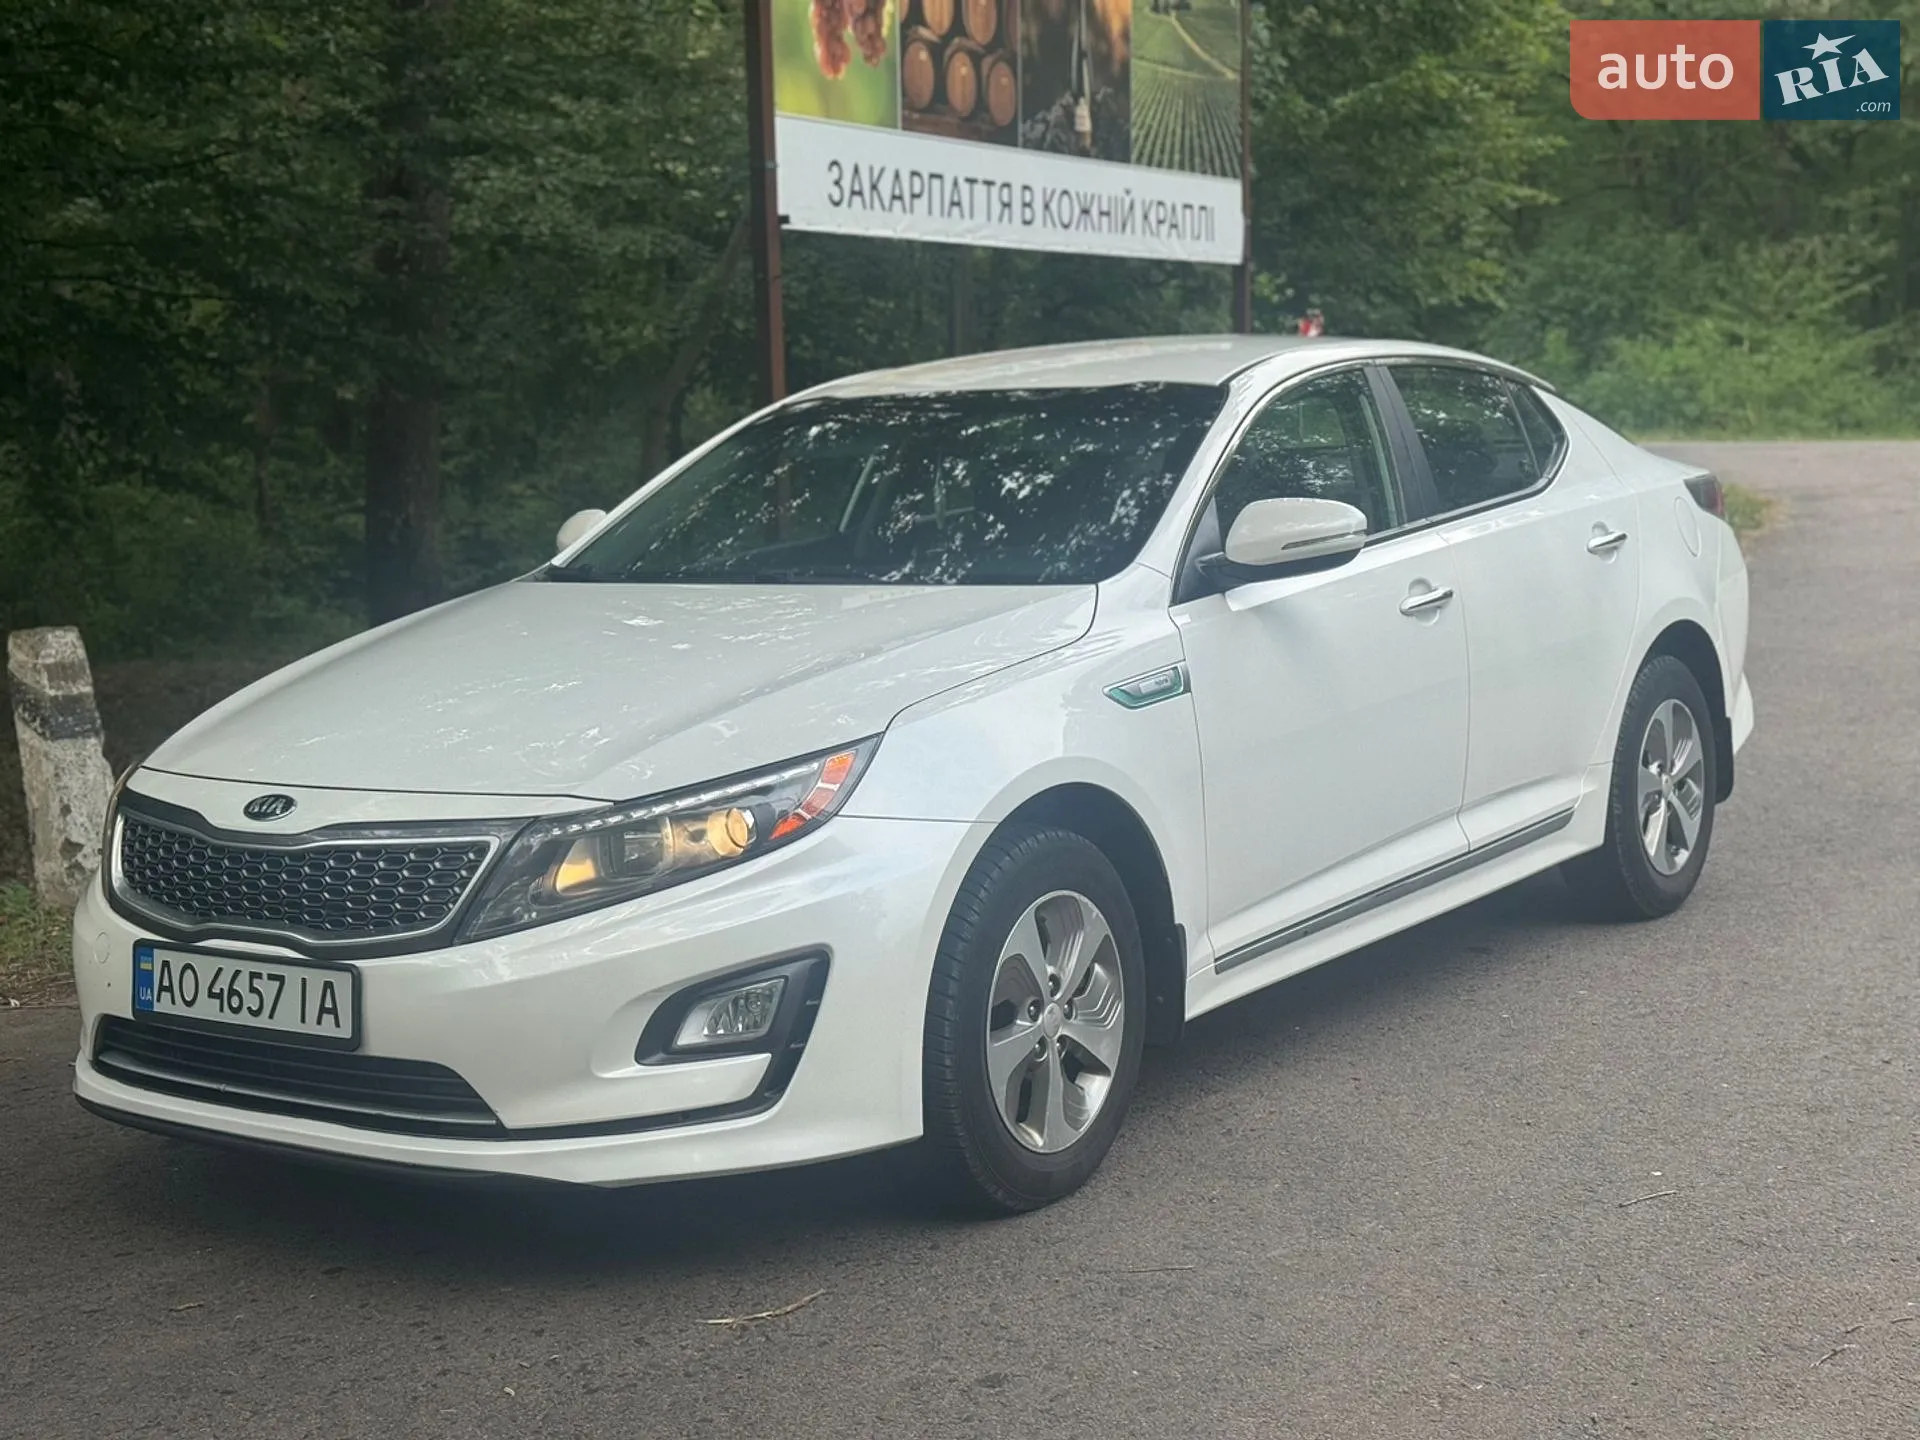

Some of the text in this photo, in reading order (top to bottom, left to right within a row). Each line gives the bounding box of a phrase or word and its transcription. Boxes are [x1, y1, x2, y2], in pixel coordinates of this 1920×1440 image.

[828, 159, 1215, 242] ЗАКАРПАТТЯ В КОЖНІЙ КРАПЛІ
[139, 986, 152, 1001] UA
[156, 960, 341, 1028] AO 4657 IA
